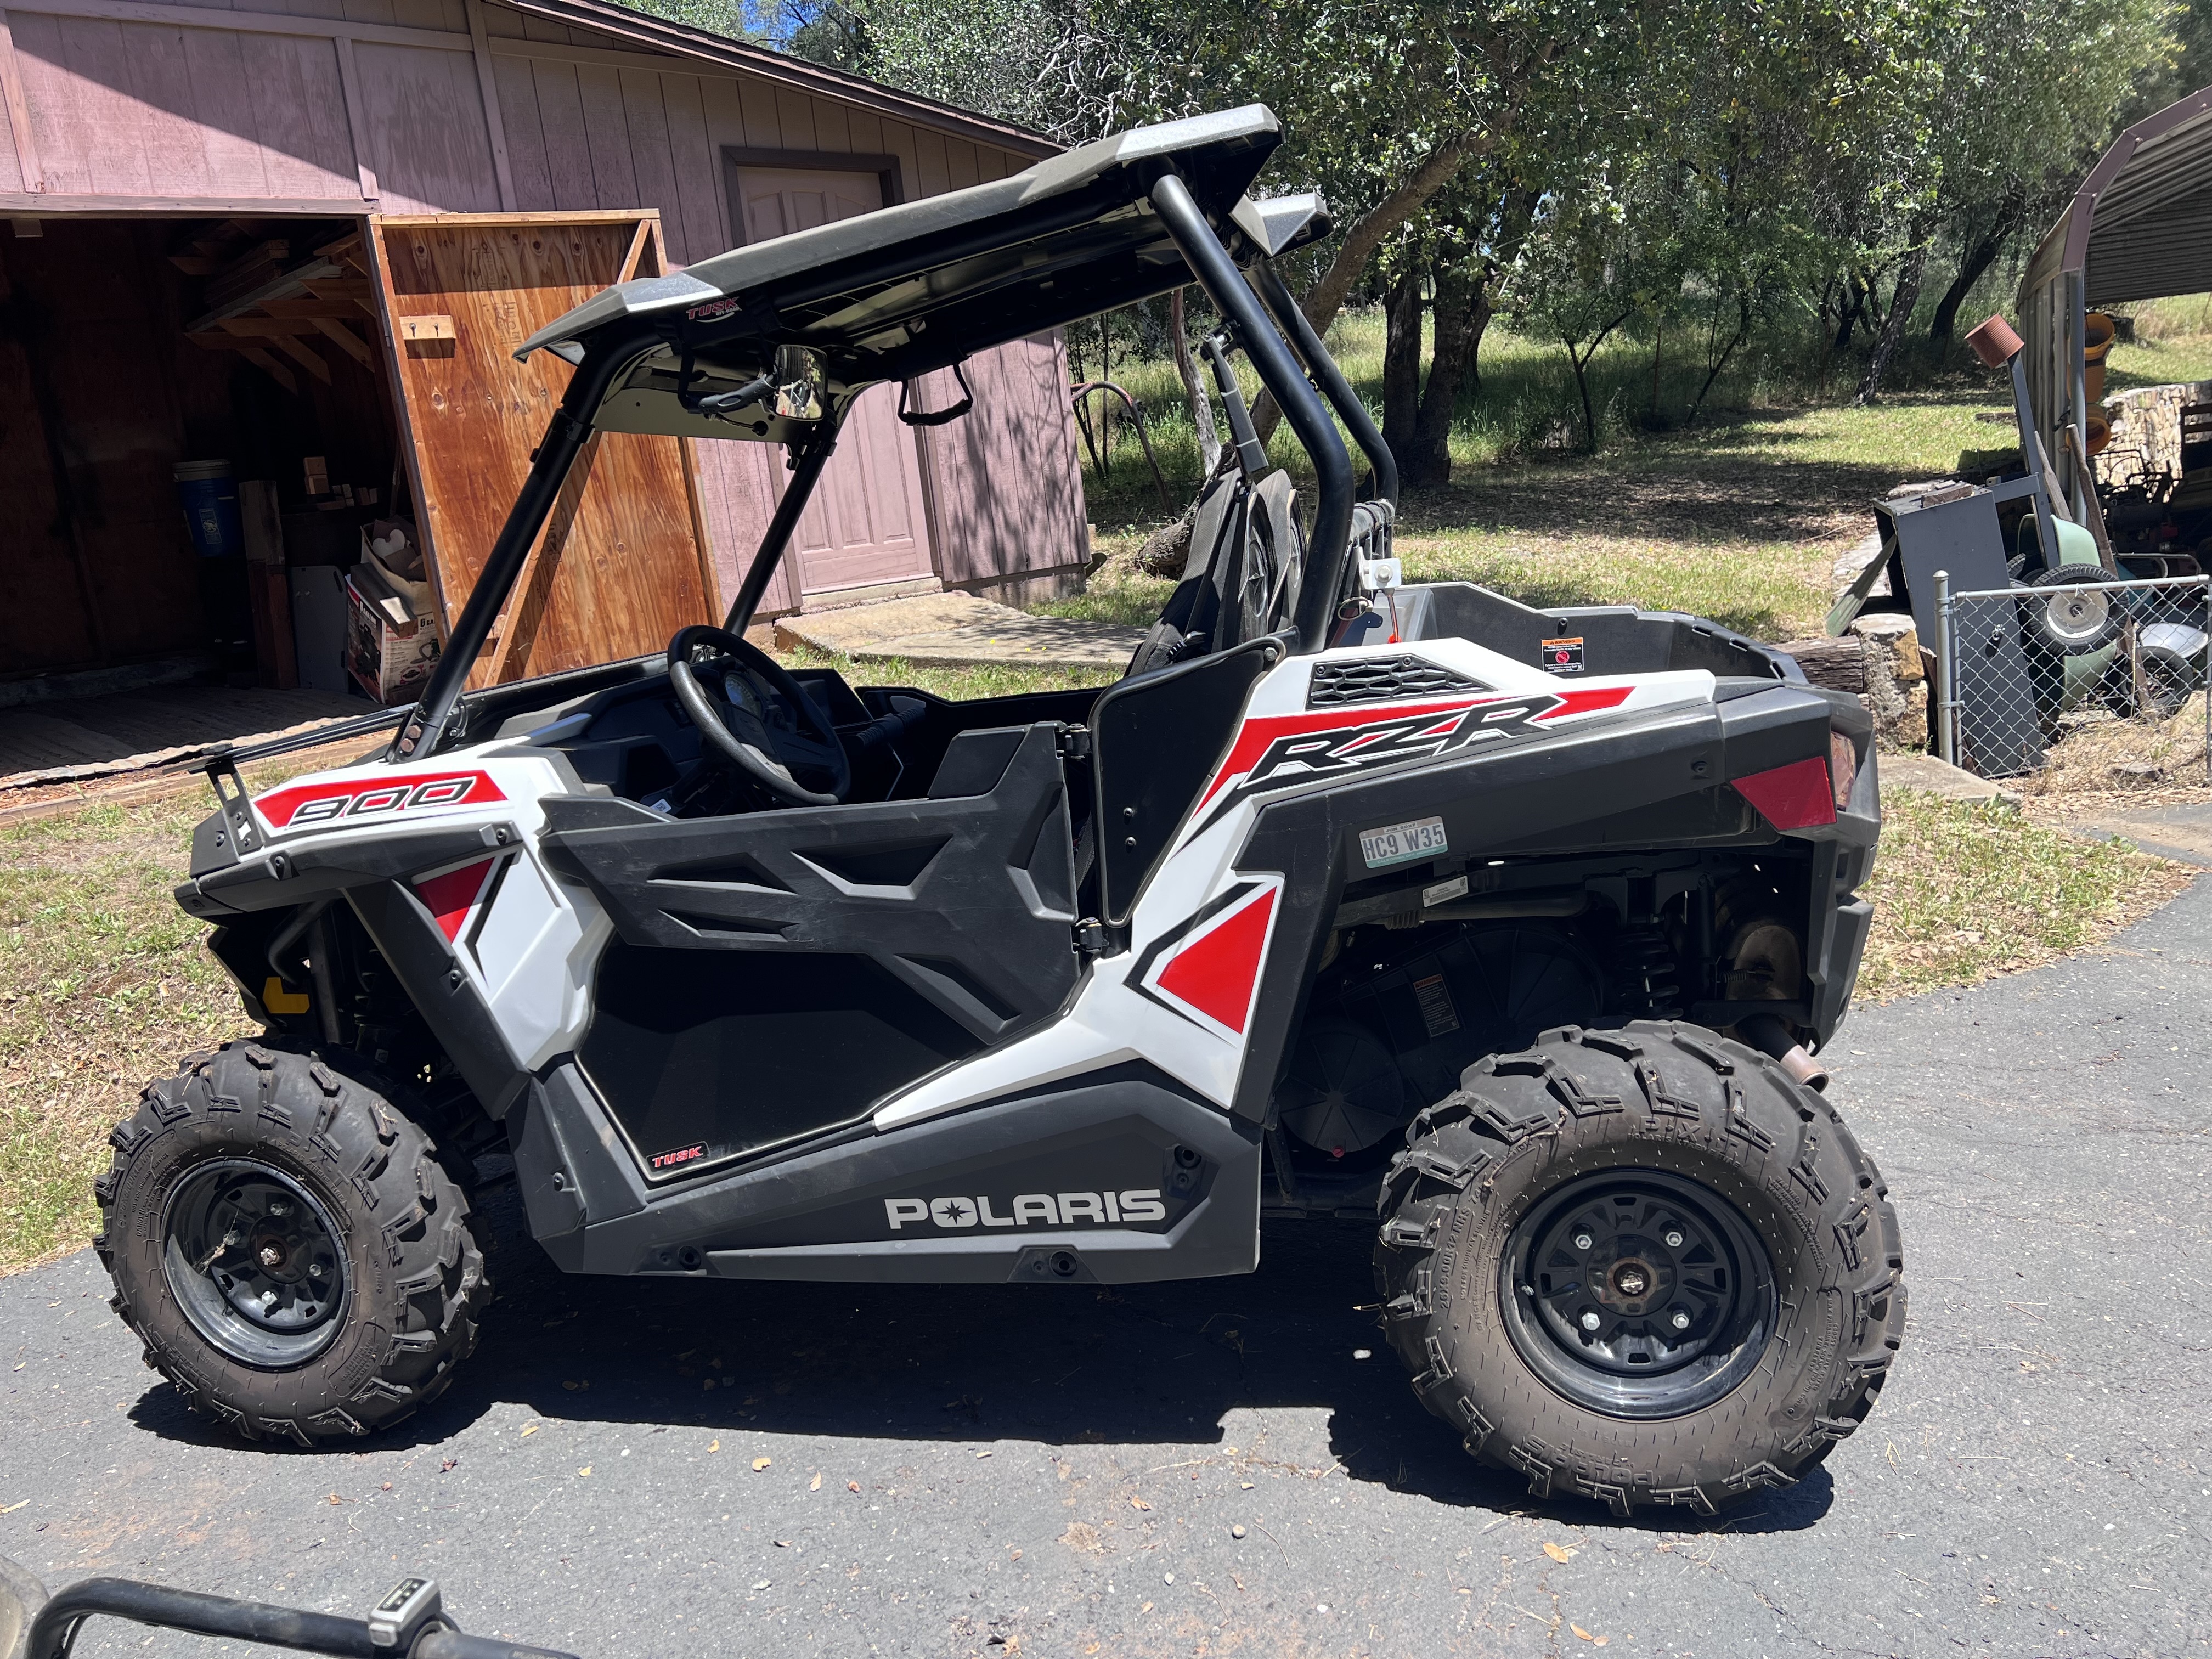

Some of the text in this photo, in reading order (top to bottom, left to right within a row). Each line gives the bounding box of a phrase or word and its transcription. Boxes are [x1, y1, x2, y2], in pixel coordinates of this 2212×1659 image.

[686, 296, 740, 320] TUSK
[1238, 694, 1568, 788] RZR
[286, 776, 477, 830] 900
[1362, 825, 1444, 860] HC9 W35
[652, 1146, 702, 1167] TUSK
[884, 1189, 1166, 1230] POLARIS
